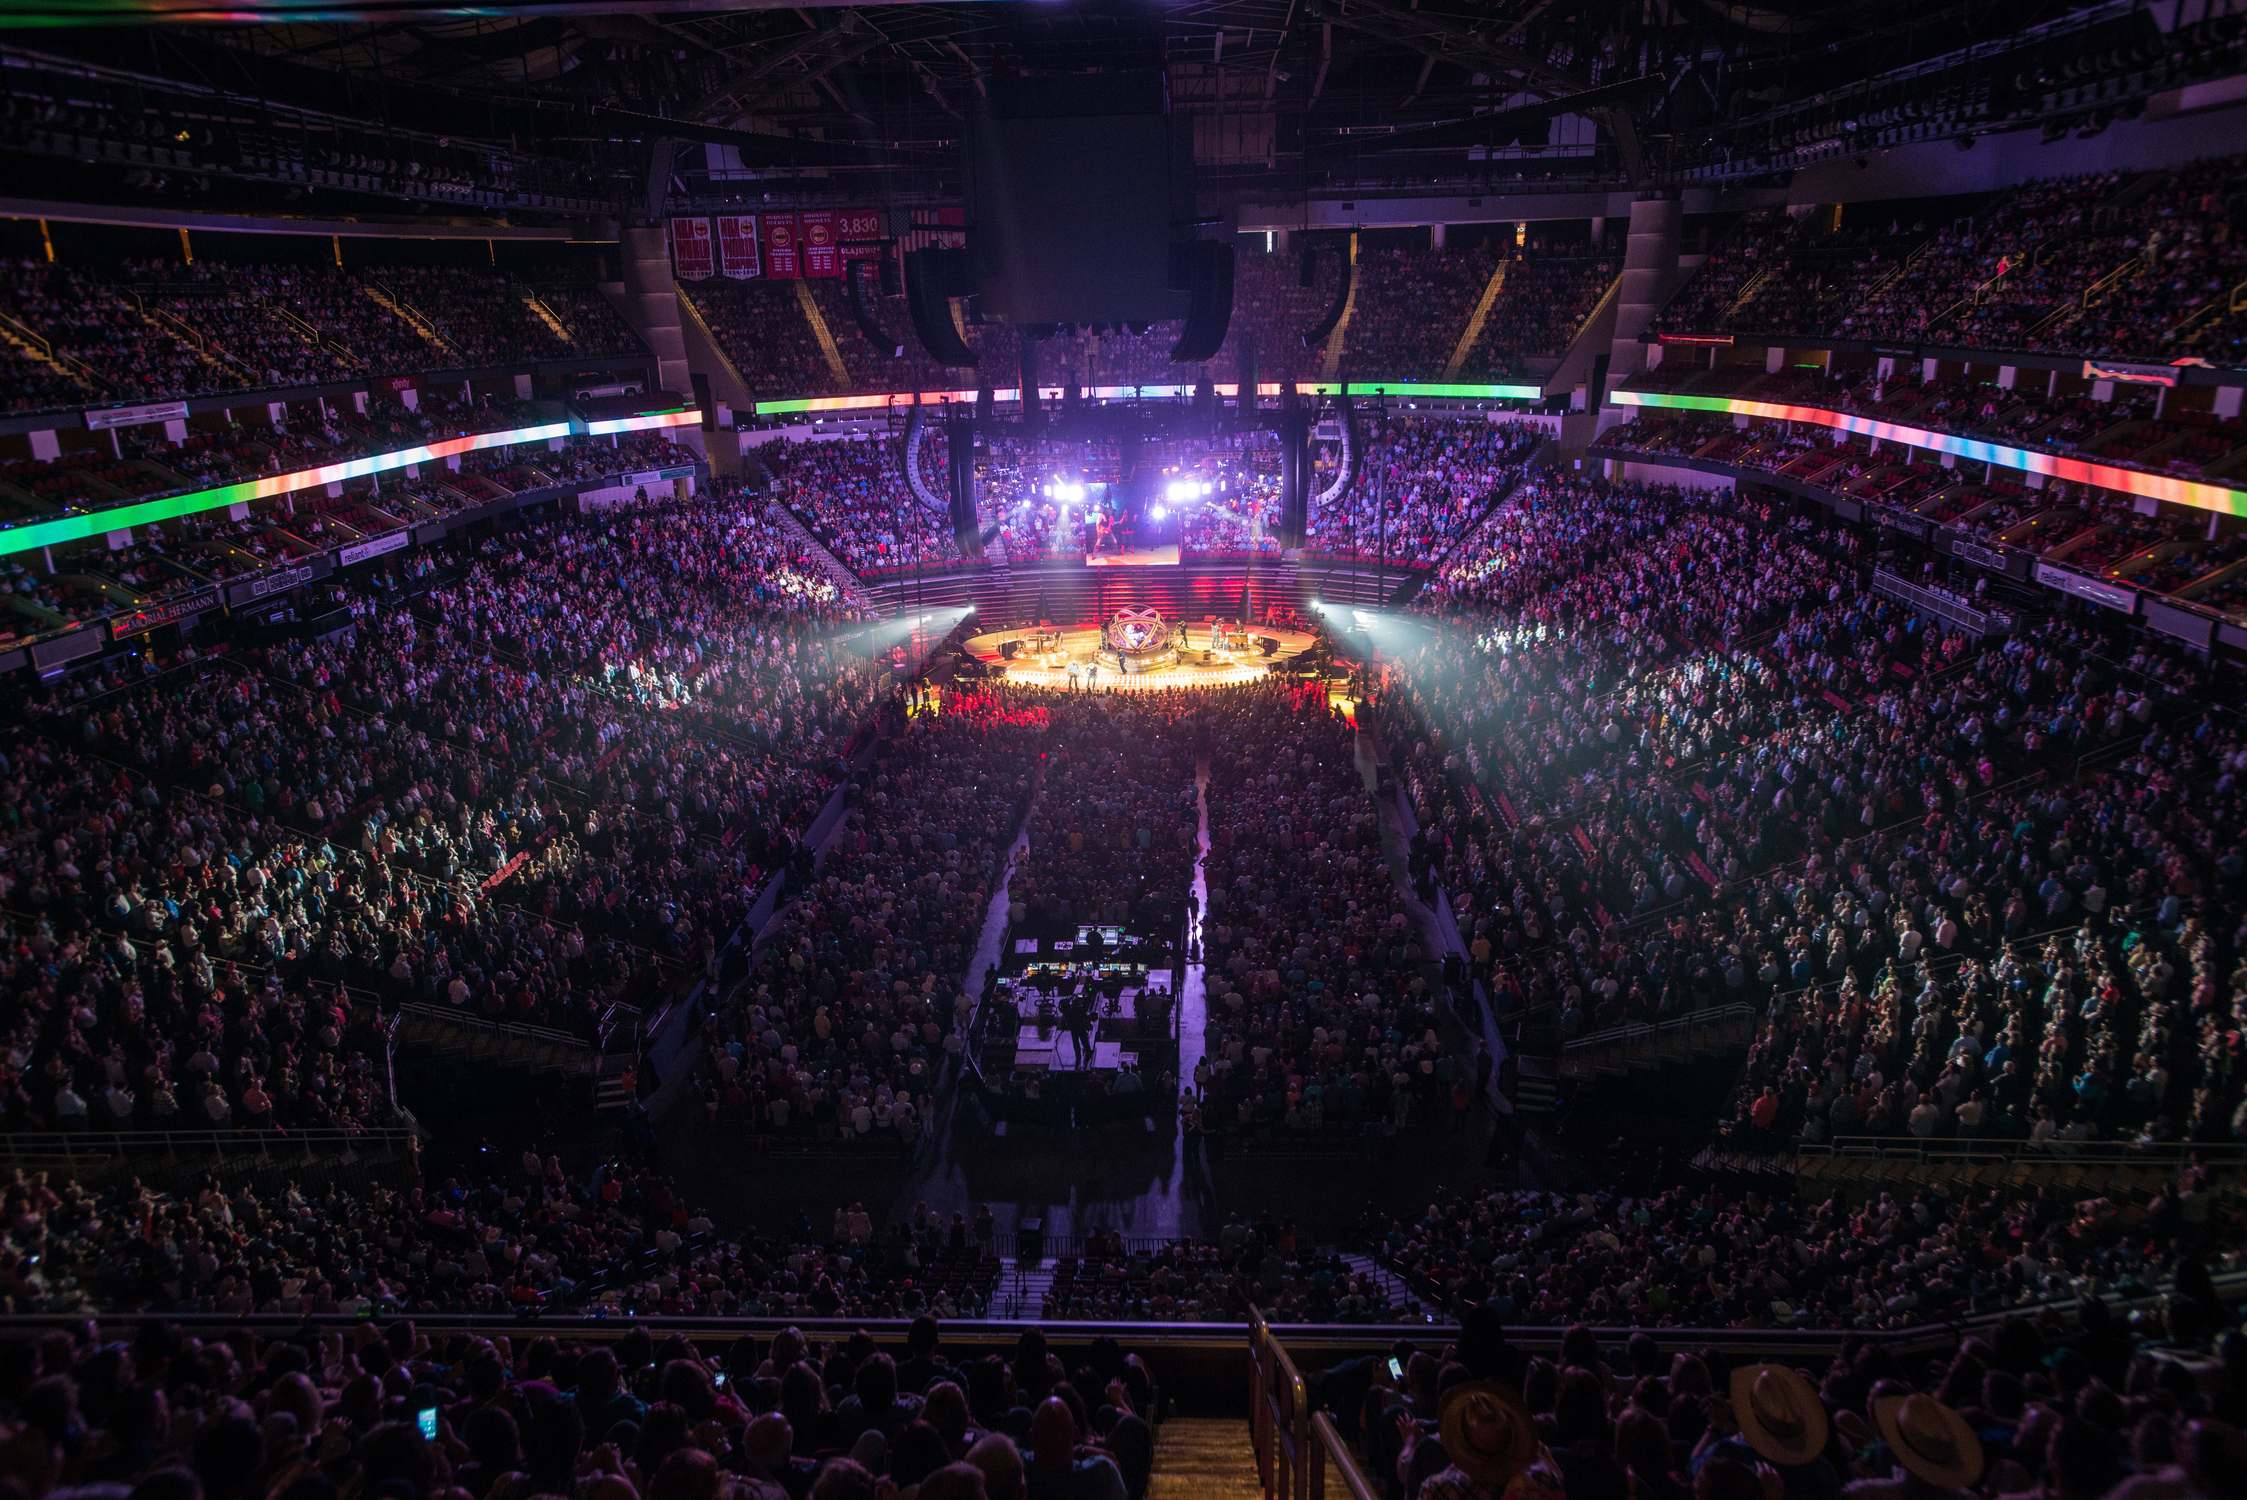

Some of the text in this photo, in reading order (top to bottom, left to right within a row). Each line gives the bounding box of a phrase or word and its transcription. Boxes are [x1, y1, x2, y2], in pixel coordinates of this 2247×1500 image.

[840, 217, 878, 235] 3,830
[344, 550, 364, 563] reliant
[2040, 572, 2066, 586] reliant
[167, 594, 215, 618] HERMANN
